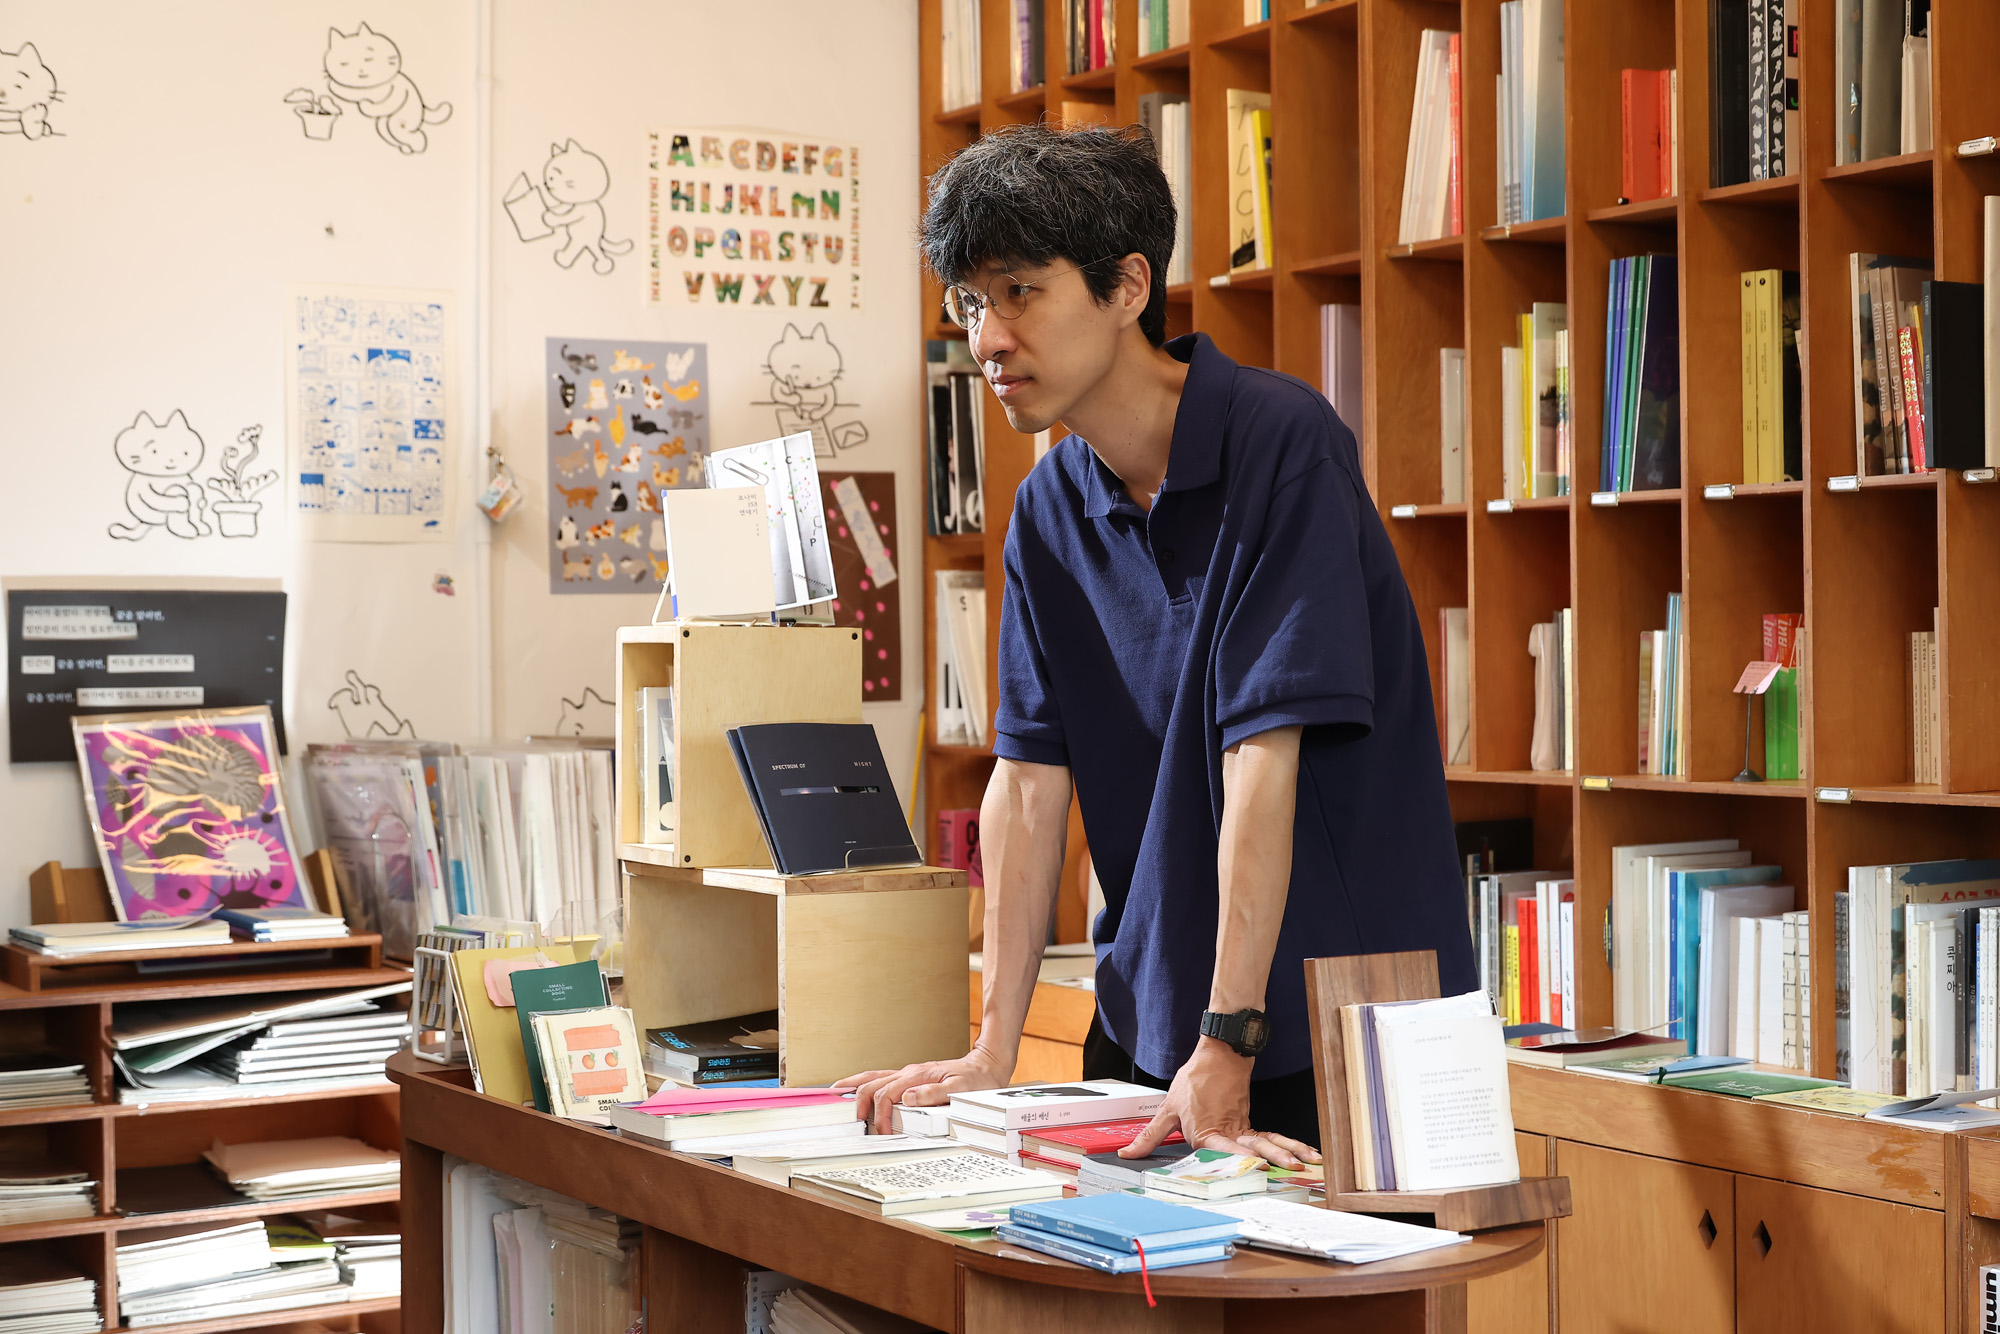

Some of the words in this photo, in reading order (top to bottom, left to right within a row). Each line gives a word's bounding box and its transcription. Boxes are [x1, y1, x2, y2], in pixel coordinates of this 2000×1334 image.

[1871, 302, 1883, 341] Killing
[1884, 301, 1894, 340] Killing
[1877, 347, 1885, 369] and
[1889, 345, 1897, 369] and
[1878, 376, 1888, 412] Dying
[1892, 374, 1901, 411] Dying
[542, 985, 573, 993] COLLECTING
[598, 1098, 621, 1106] SMALL
